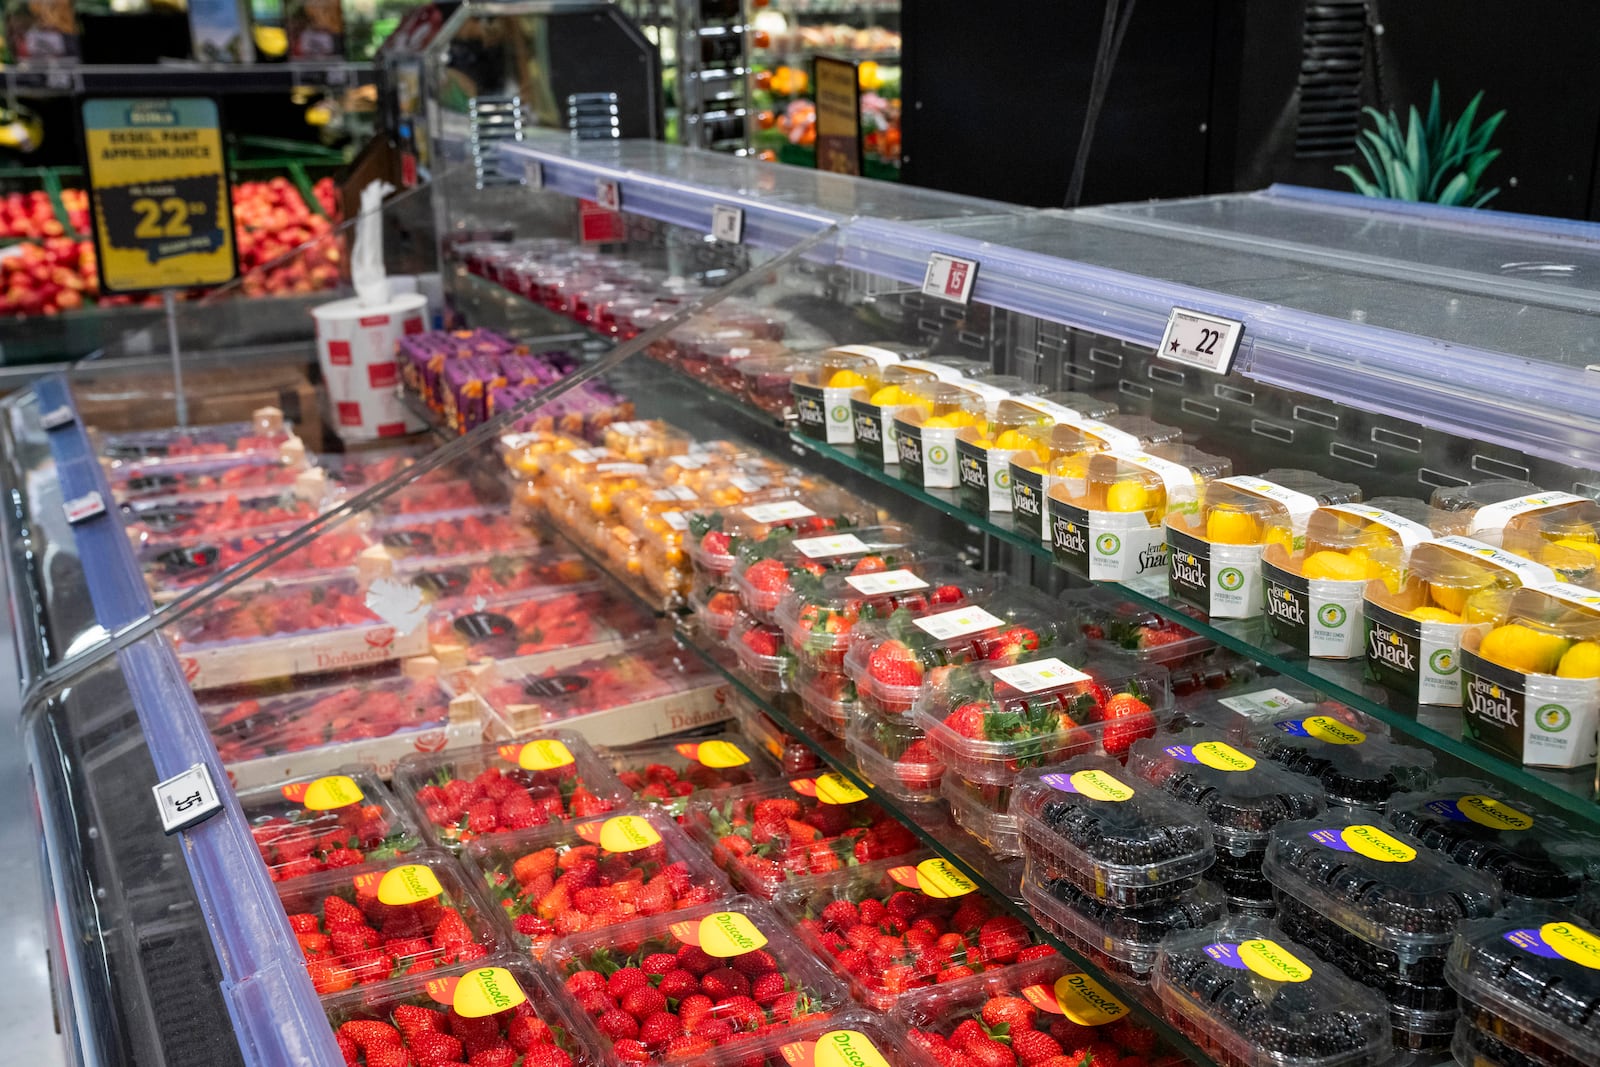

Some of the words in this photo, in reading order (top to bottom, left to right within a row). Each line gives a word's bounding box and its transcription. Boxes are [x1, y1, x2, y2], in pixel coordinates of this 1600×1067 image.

[132, 196, 193, 238] 22
[1195, 327, 1220, 355] 22
[1012, 485, 1040, 515] Snack
[1053, 521, 1086, 553] Snack
[1136, 550, 1168, 575] Snac
[1171, 553, 1207, 588] Snack
[1267, 588, 1306, 625] Snack
[1369, 630, 1416, 671] Snack
[1466, 681, 1519, 728] Snack
[174, 790, 202, 812] 35
